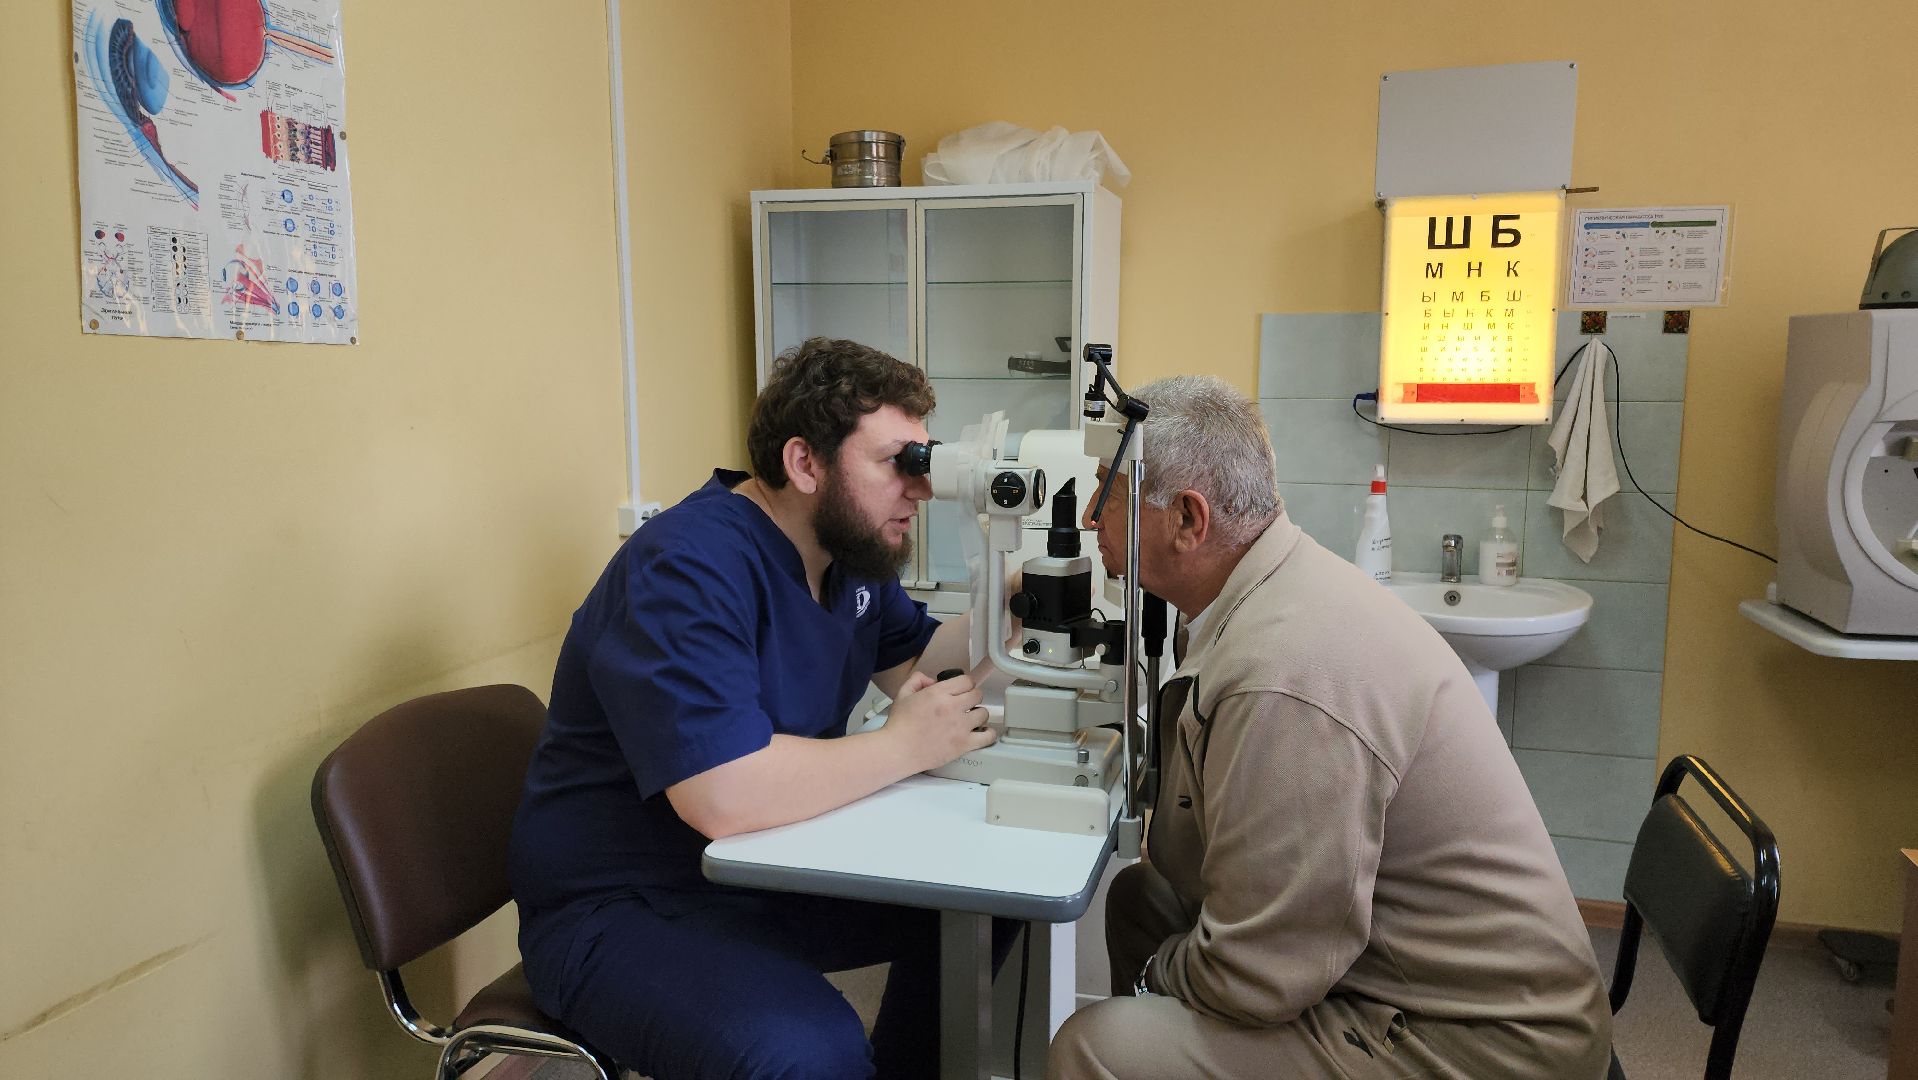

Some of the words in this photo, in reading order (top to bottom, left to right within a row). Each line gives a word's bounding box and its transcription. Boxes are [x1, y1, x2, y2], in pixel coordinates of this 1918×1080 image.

[1428, 216, 1472, 250] Ш
[1491, 214, 1522, 248] Б
[1425, 262, 1444, 279] М
[1467, 261, 1482, 278] Н
[1506, 260, 1521, 278] К
[1422, 292, 1436, 303] Ы
[1452, 292, 1465, 303] М
[1481, 291, 1491, 302] Б
[1507, 290, 1522, 302] Ш
[1424, 309, 1432, 318] Б
[1443, 309, 1455, 318] Ы
[1486, 309, 1494, 318] К
[1441, 323, 1449, 331] Н
[1487, 323, 1496, 331] М
